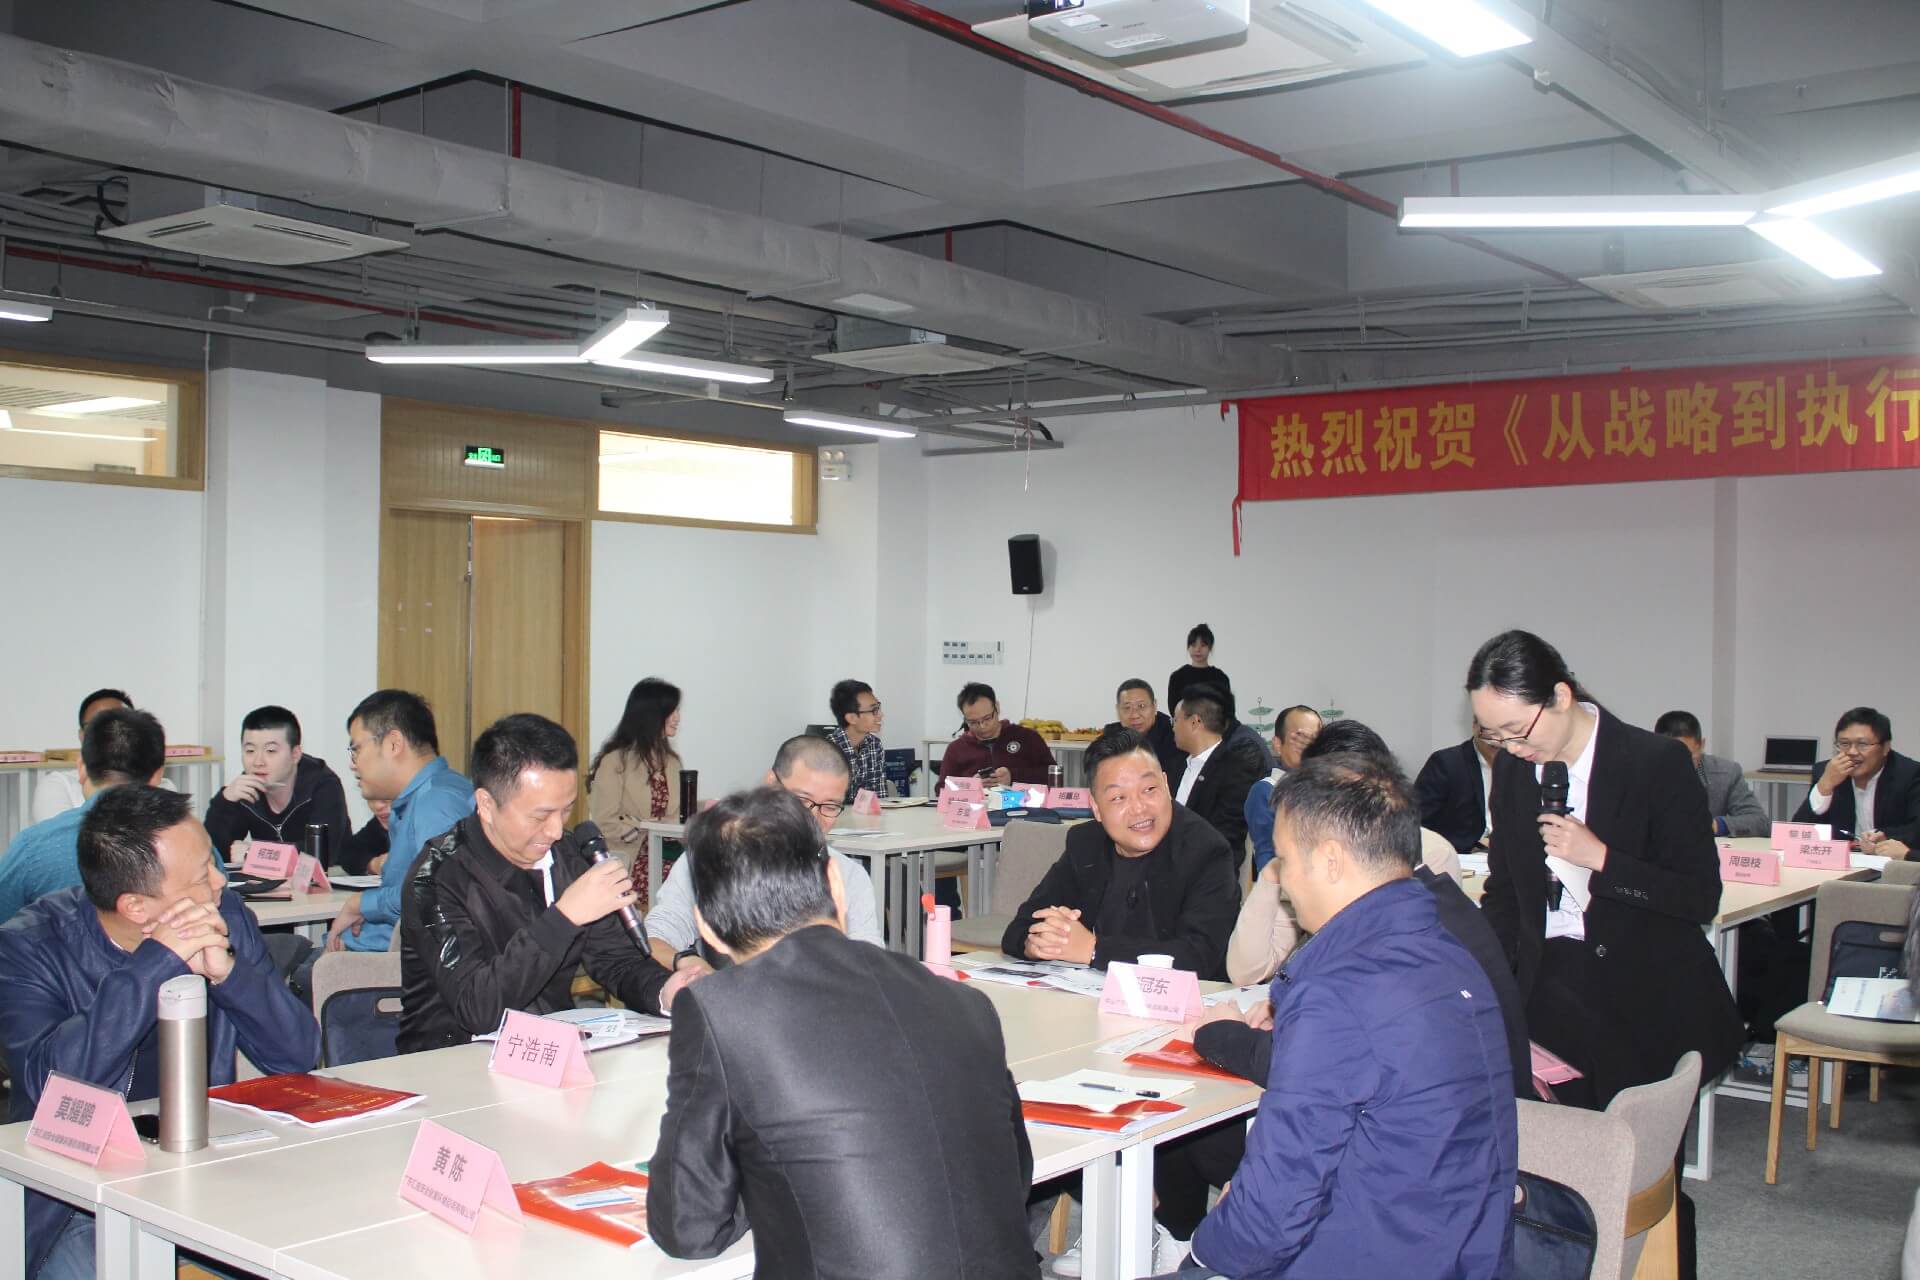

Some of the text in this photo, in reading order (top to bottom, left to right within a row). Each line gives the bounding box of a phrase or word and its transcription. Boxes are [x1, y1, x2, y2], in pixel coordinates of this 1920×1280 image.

[1270, 366, 1920, 479] 热烈祝贺《从战略到执行
[1135, 976, 1171, 995] 冠东
[508, 1033, 560, 1067] 宁浩南
